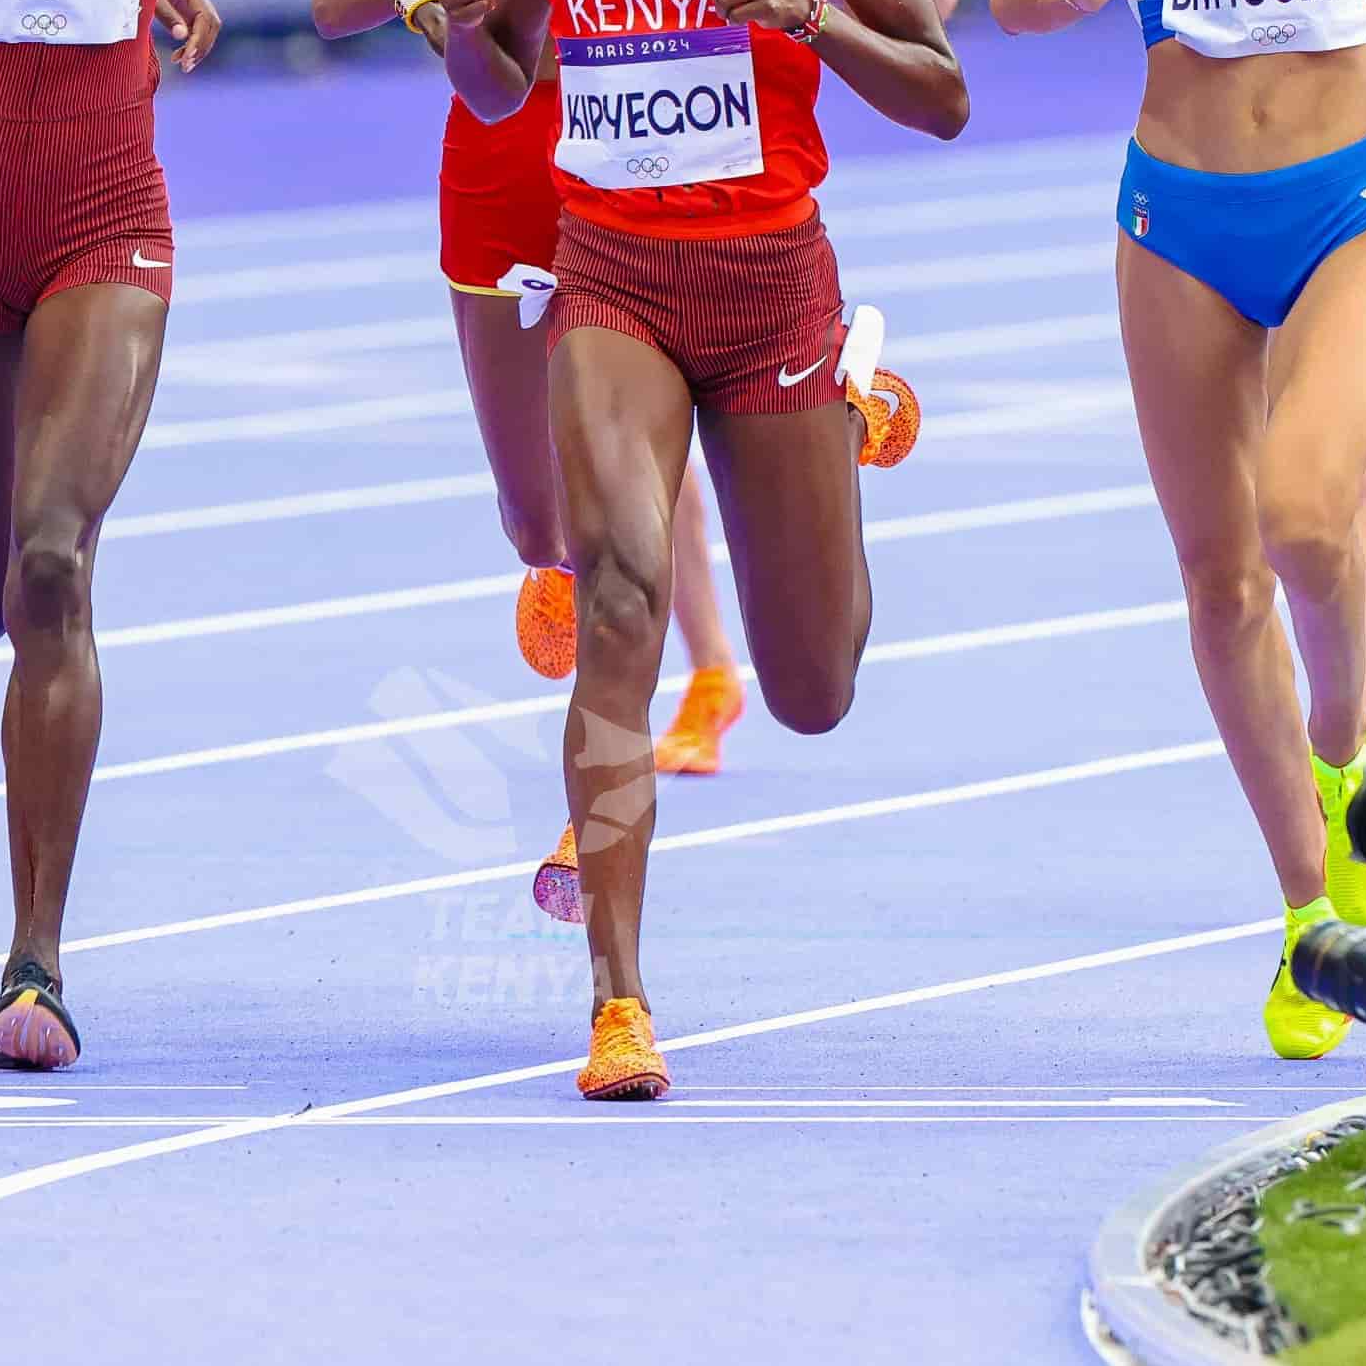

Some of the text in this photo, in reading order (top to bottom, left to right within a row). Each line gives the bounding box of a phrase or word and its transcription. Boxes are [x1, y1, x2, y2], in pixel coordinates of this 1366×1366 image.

[587, 38, 690, 59] PARIS 2024
[567, 81, 751, 140] KIPYEGON
